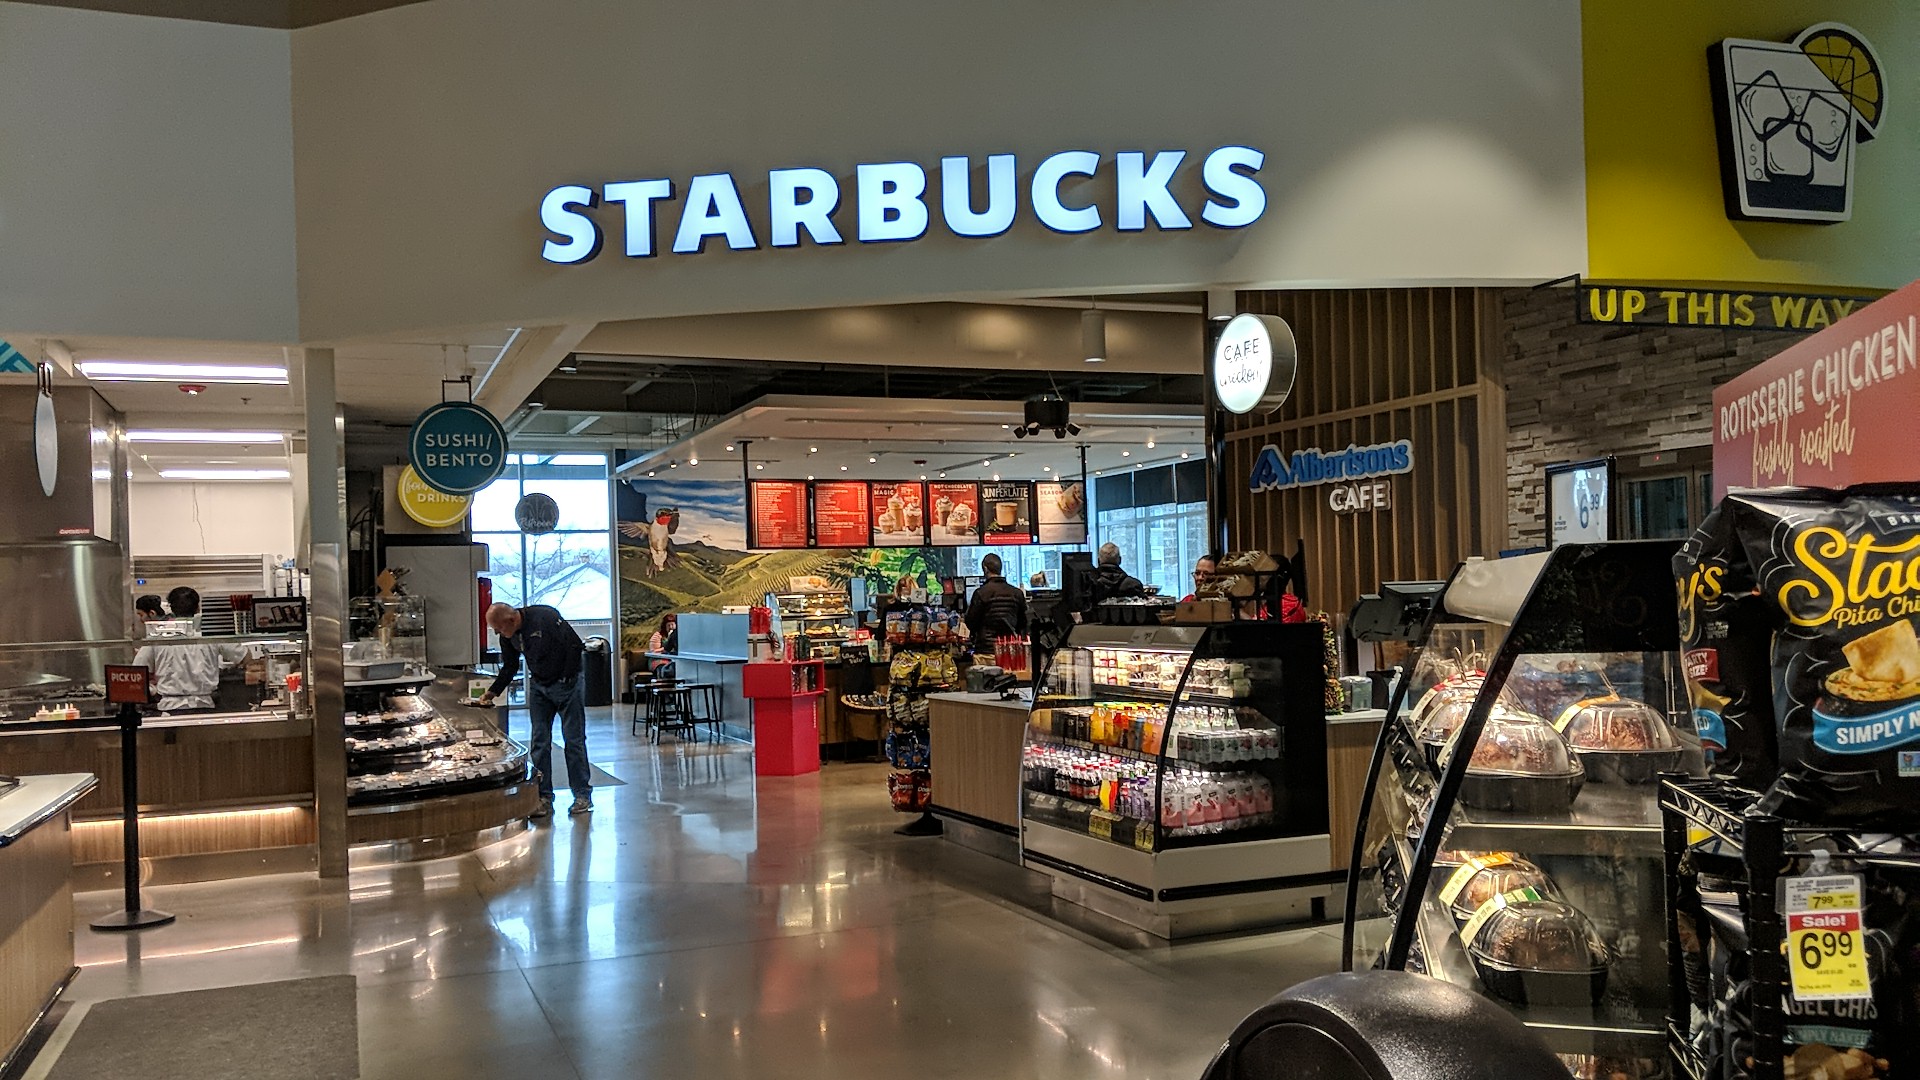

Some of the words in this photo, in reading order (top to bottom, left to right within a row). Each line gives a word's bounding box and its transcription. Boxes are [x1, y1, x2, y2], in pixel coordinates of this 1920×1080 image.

[539, 145, 1268, 265] STARBUCKS
[1589, 288, 1646, 322] UP
[1660, 291, 1756, 327] THIS
[1223, 337, 1260, 361] CAFE
[1720, 368, 1805, 443] ROTISSERIE
[1811, 315, 1917, 406] CHICKEN
[425, 433, 492, 450] SUSHI/
[1752, 405, 1795, 487] freshly
[1799, 388, 1856, 471] roasted
[426, 453, 494, 467] BENTO
[1288, 442, 1411, 485] Albertsons
[417, 493, 466, 503] DRINKS
[1329, 482, 1389, 512] CAFE
[1833, 605, 1884, 629] Pita
[111, 672, 130, 682] PICK
[130, 673, 143, 683] UP
[1836, 715, 1905, 744] SIMPLY
[1801, 914, 1846, 928] Sale!
